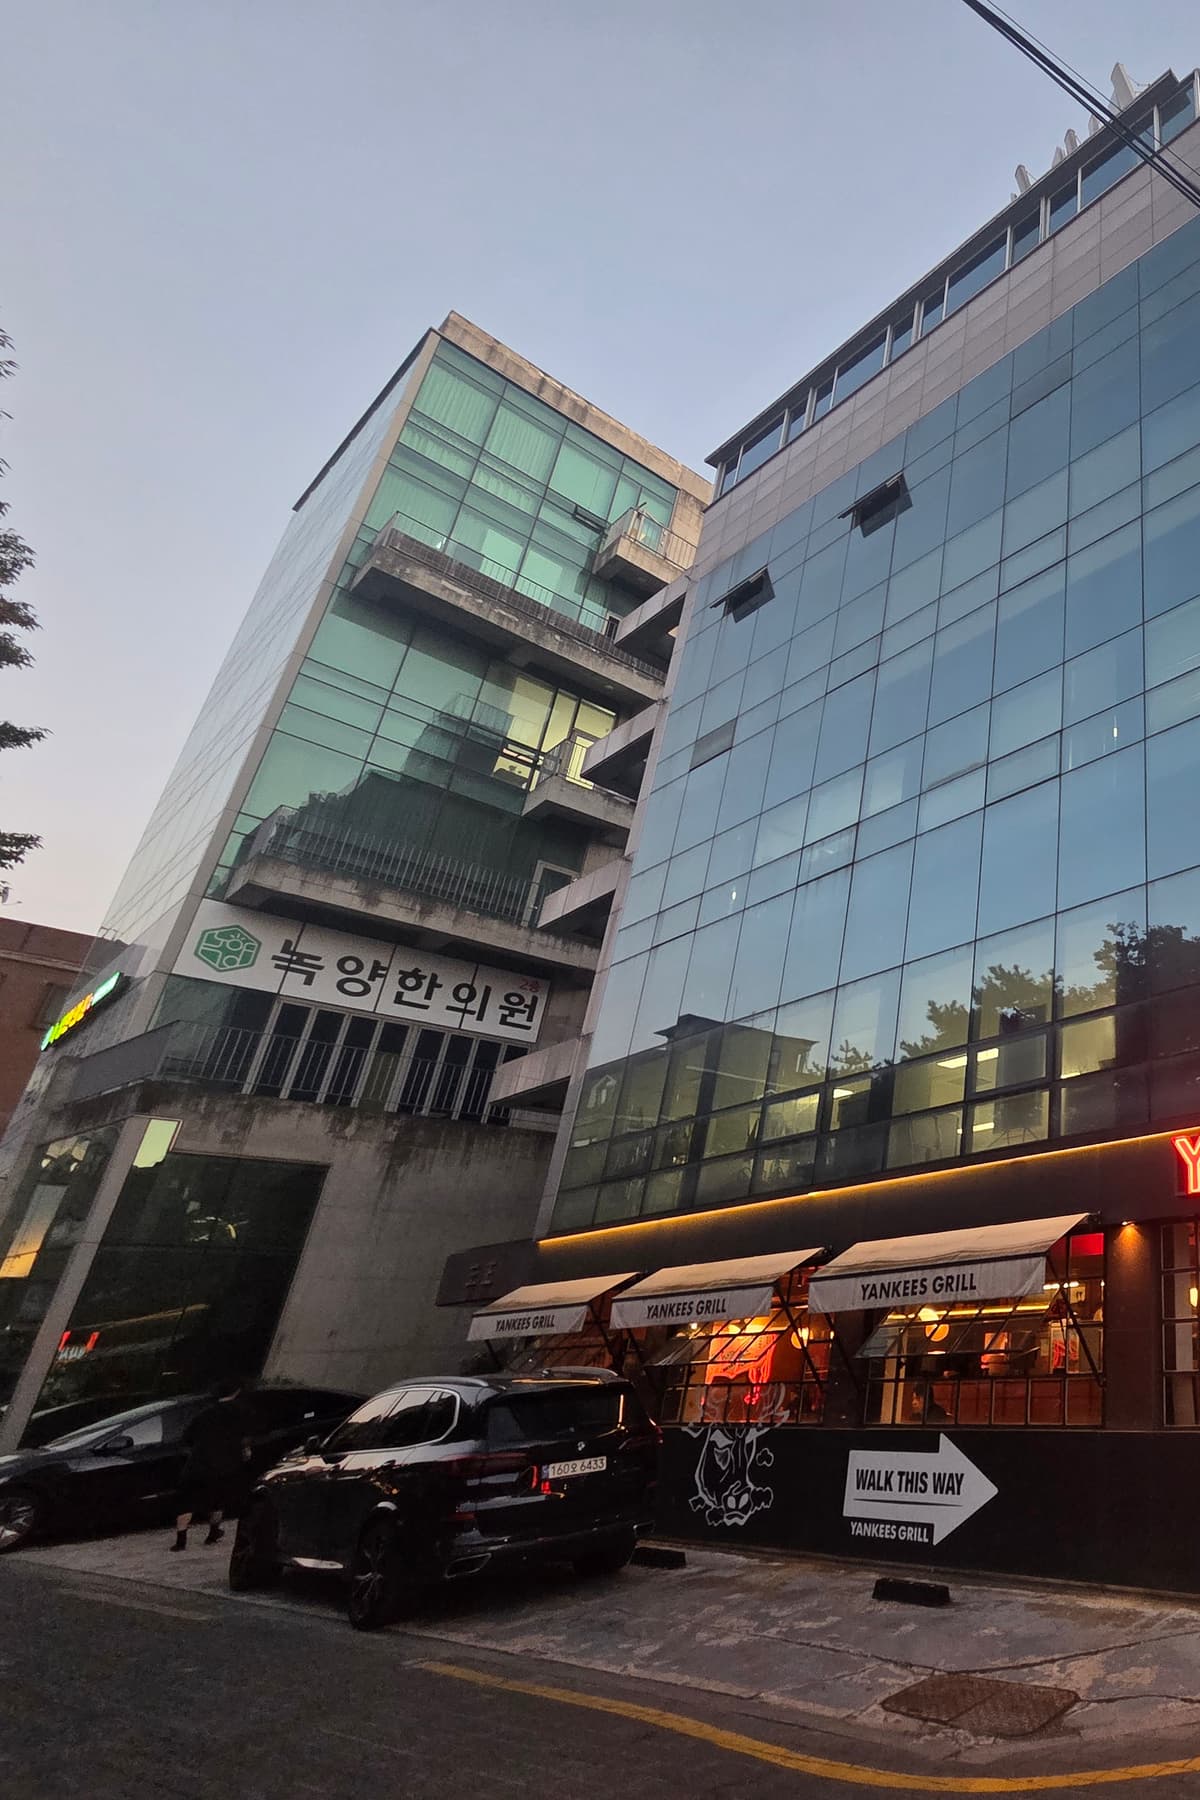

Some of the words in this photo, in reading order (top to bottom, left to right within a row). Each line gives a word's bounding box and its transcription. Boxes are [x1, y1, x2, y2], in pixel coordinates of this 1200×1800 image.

[271, 938, 538, 1031] 녹양한의원
[519, 978, 540, 993] 2층
[861, 1277, 927, 1301] YANKEES
[932, 1273, 977, 1294] GRILL
[646, 1301, 694, 1319] YANKEES
[695, 1298, 727, 1316] GRILL
[495, 1316, 531, 1332] YANKEES
[532, 1314, 555, 1329] GRILL
[551, 1462, 578, 1477] 160오
[580, 1458, 605, 1472] 6433
[855, 1468, 895, 1493] WALK
[897, 1470, 929, 1494] THIS
[932, 1472, 965, 1496] WAY
[850, 1521, 897, 1540] YANKEES
[898, 1525, 929, 1543] GRILL
